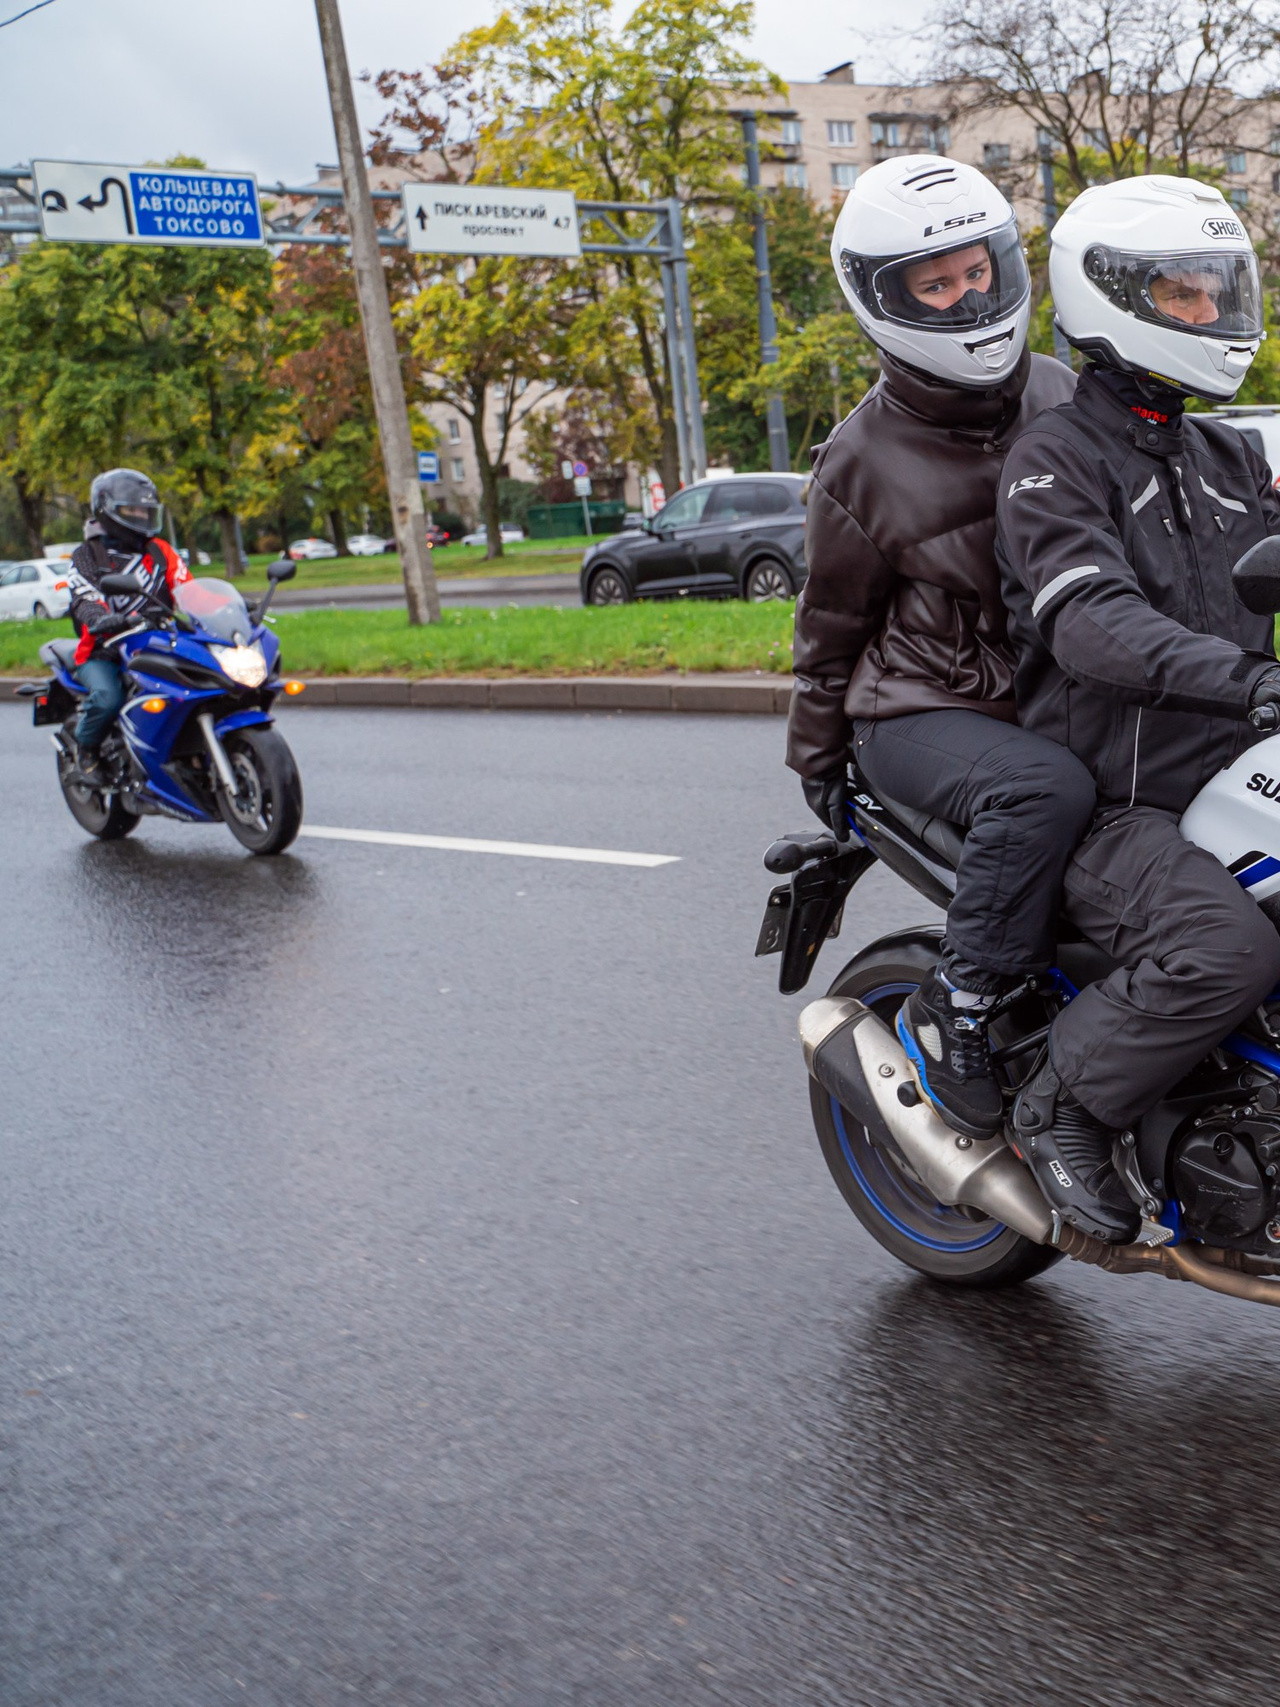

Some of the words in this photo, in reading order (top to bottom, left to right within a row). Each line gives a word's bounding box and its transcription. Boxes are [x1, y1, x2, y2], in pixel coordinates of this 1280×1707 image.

[138, 177, 249, 197] КОЛЬЦЕВАЯ
[139, 195, 254, 216] АВТОДОРОГА
[154, 216, 245, 235] ТОКСОВО
[463, 224, 524, 237] проспект
[923, 211, 987, 238] LS2
[1007, 474, 1055, 499] LS2
[853, 793, 884, 810] SV
[1050, 1161, 1072, 1187] MCP
